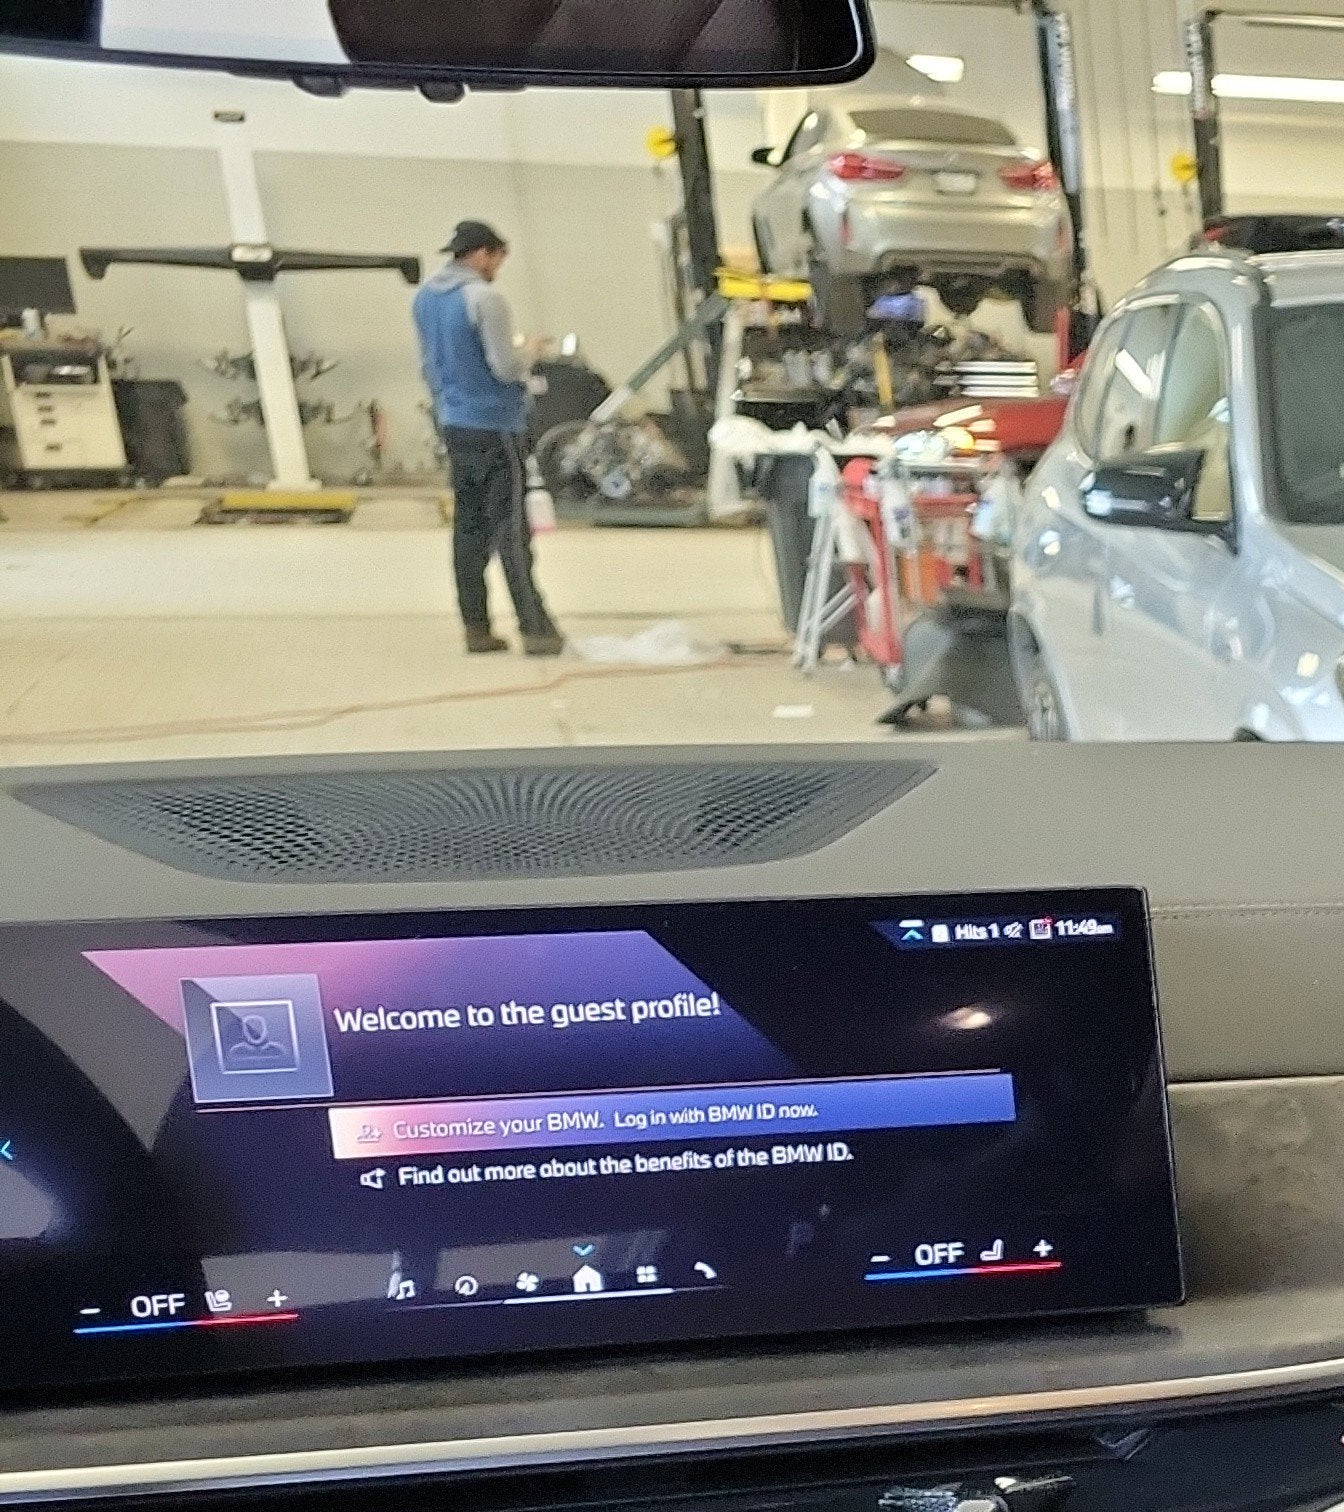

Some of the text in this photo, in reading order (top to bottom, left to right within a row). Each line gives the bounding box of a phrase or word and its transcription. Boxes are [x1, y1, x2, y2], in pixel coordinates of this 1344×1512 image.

[334, 991, 721, 1034] Welcome to the guest profile!
[393, 1102, 820, 1140] Customize your BMW. Log in with BMW ID now.
[399, 1142, 855, 1187] Find out more about the benefits of the BMW ID.
[914, 1242, 965, 1266] OFF
[130, 1293, 186, 1319] OFF
